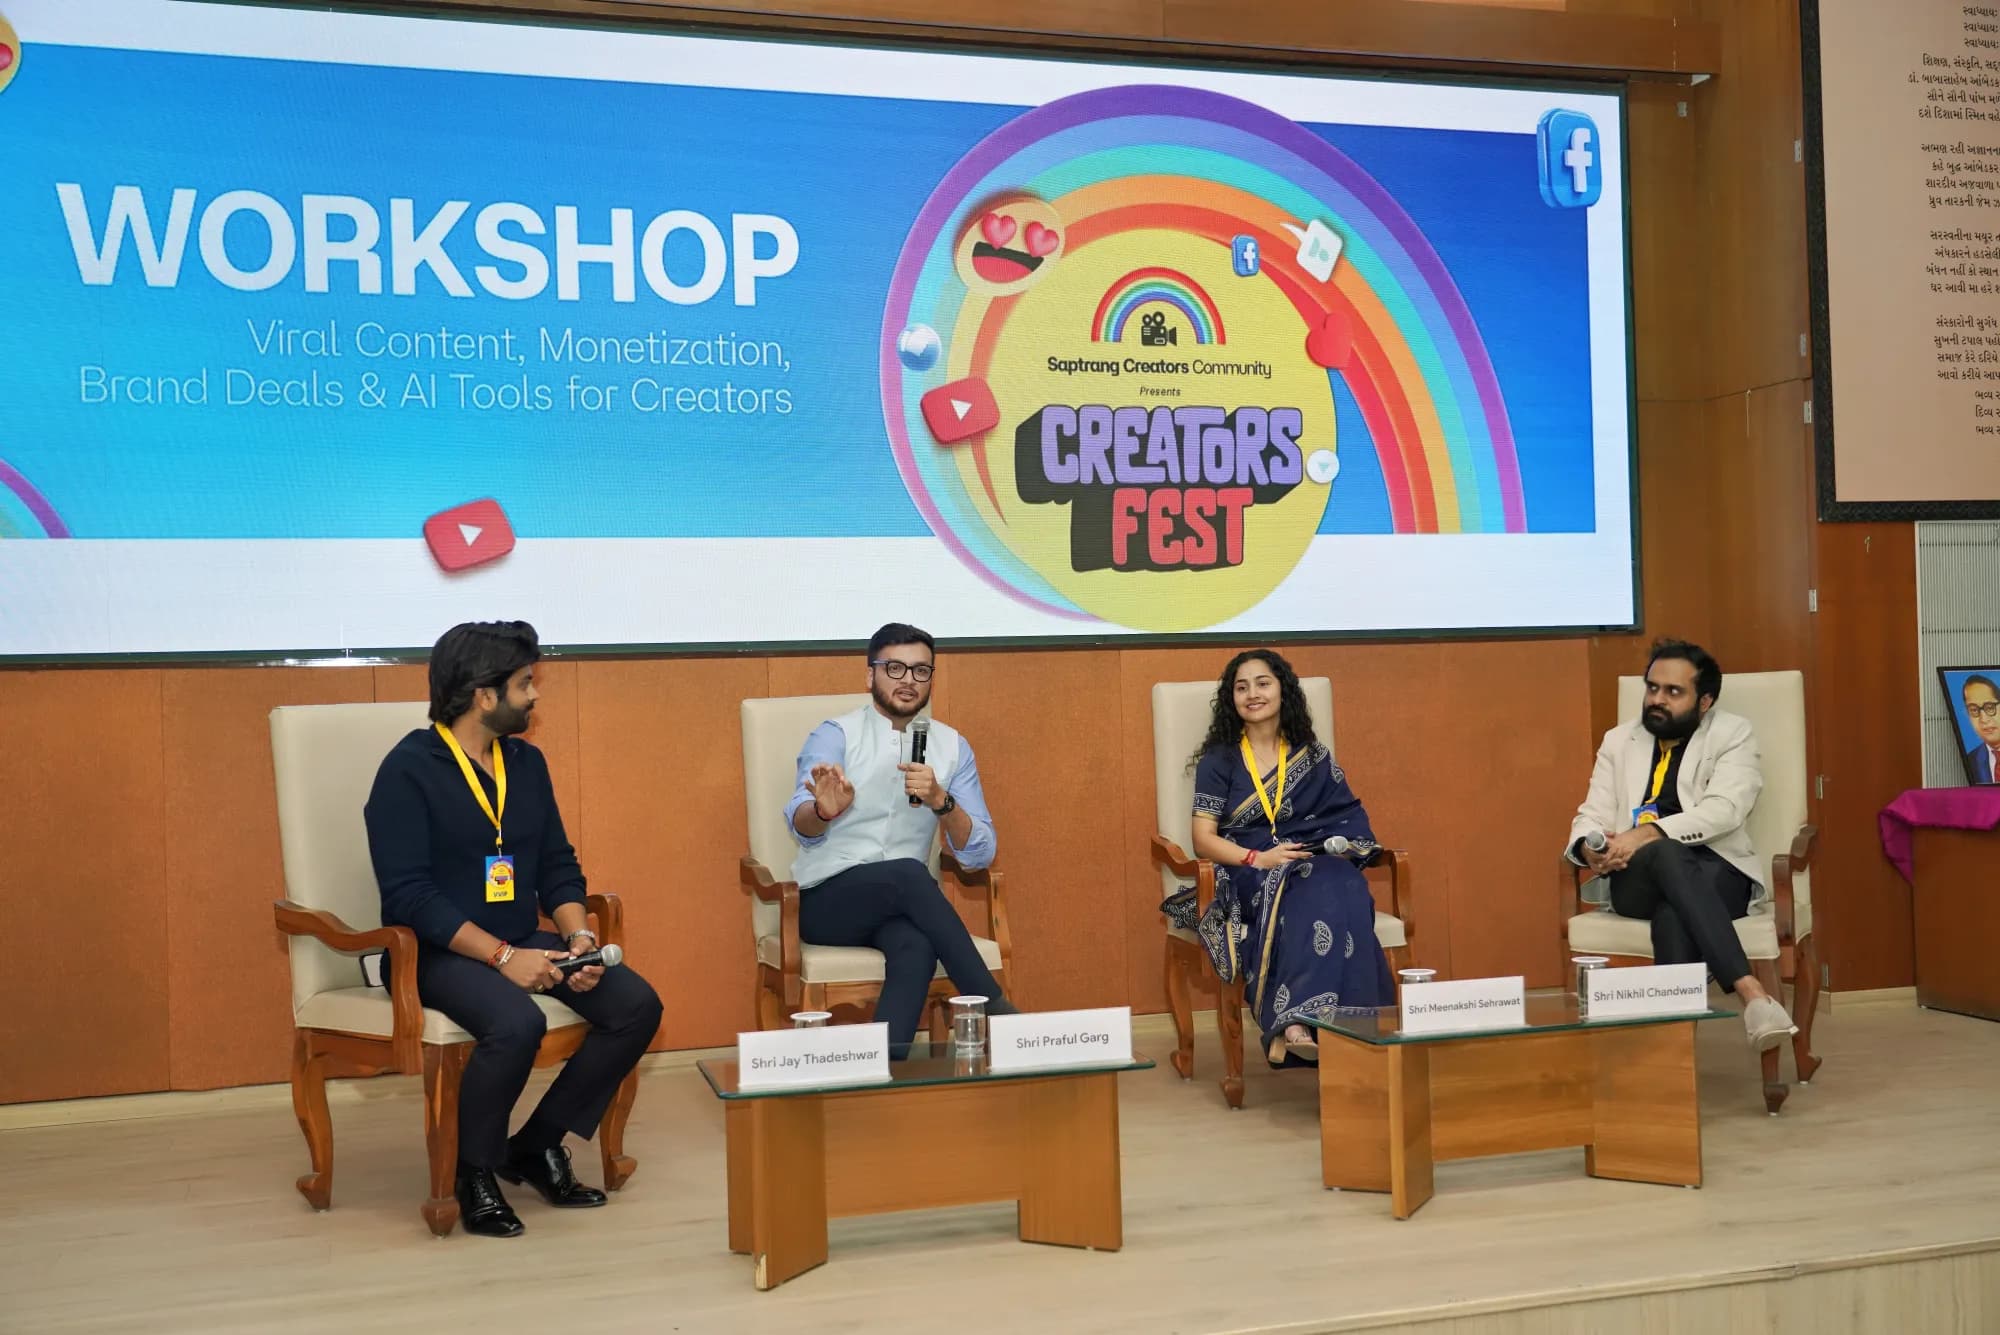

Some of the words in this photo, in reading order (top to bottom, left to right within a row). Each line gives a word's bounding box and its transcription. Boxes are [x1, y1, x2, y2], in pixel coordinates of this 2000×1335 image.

[56, 182, 800, 307] WORKSHOP
[246, 319, 342, 357] Viral
[355, 322, 526, 366] Content,
[539, 327, 792, 372] Monetization,
[1047, 356, 1120, 376] Saptrang
[1123, 358, 1189, 374] Creators
[1192, 359, 1272, 379] Community
[79, 365, 208, 406] Brand
[225, 368, 344, 408] Deals
[358, 371, 388, 409] &
[399, 373, 436, 409] AI
[449, 373, 553, 411] Tools
[566, 374, 619, 412] for
[631, 378, 793, 414] Creators
[1139, 386, 1181, 398] Presents
[1038, 404, 1304, 487] CREATORS
[1110, 487, 1255, 567] FEST
[1594, 990, 1613, 1001] Shri
[1616, 987, 1644, 999] Nikhil
[1647, 984, 1703, 998] Chandwani
[1408, 1004, 1427, 1014] Shri
[1429, 999, 1476, 1012] Meenakshi
[1478, 998, 1520, 1009] Sehrawat
[1016, 1036, 1040, 1048] Shri
[1043, 1032, 1077, 1046] Praful
[1079, 1032, 1109, 1044] Garg
[751, 1056, 776, 1069] Shri
[779, 1056, 801, 1069] Jay
[803, 1050, 879, 1065] Thadeshwar
